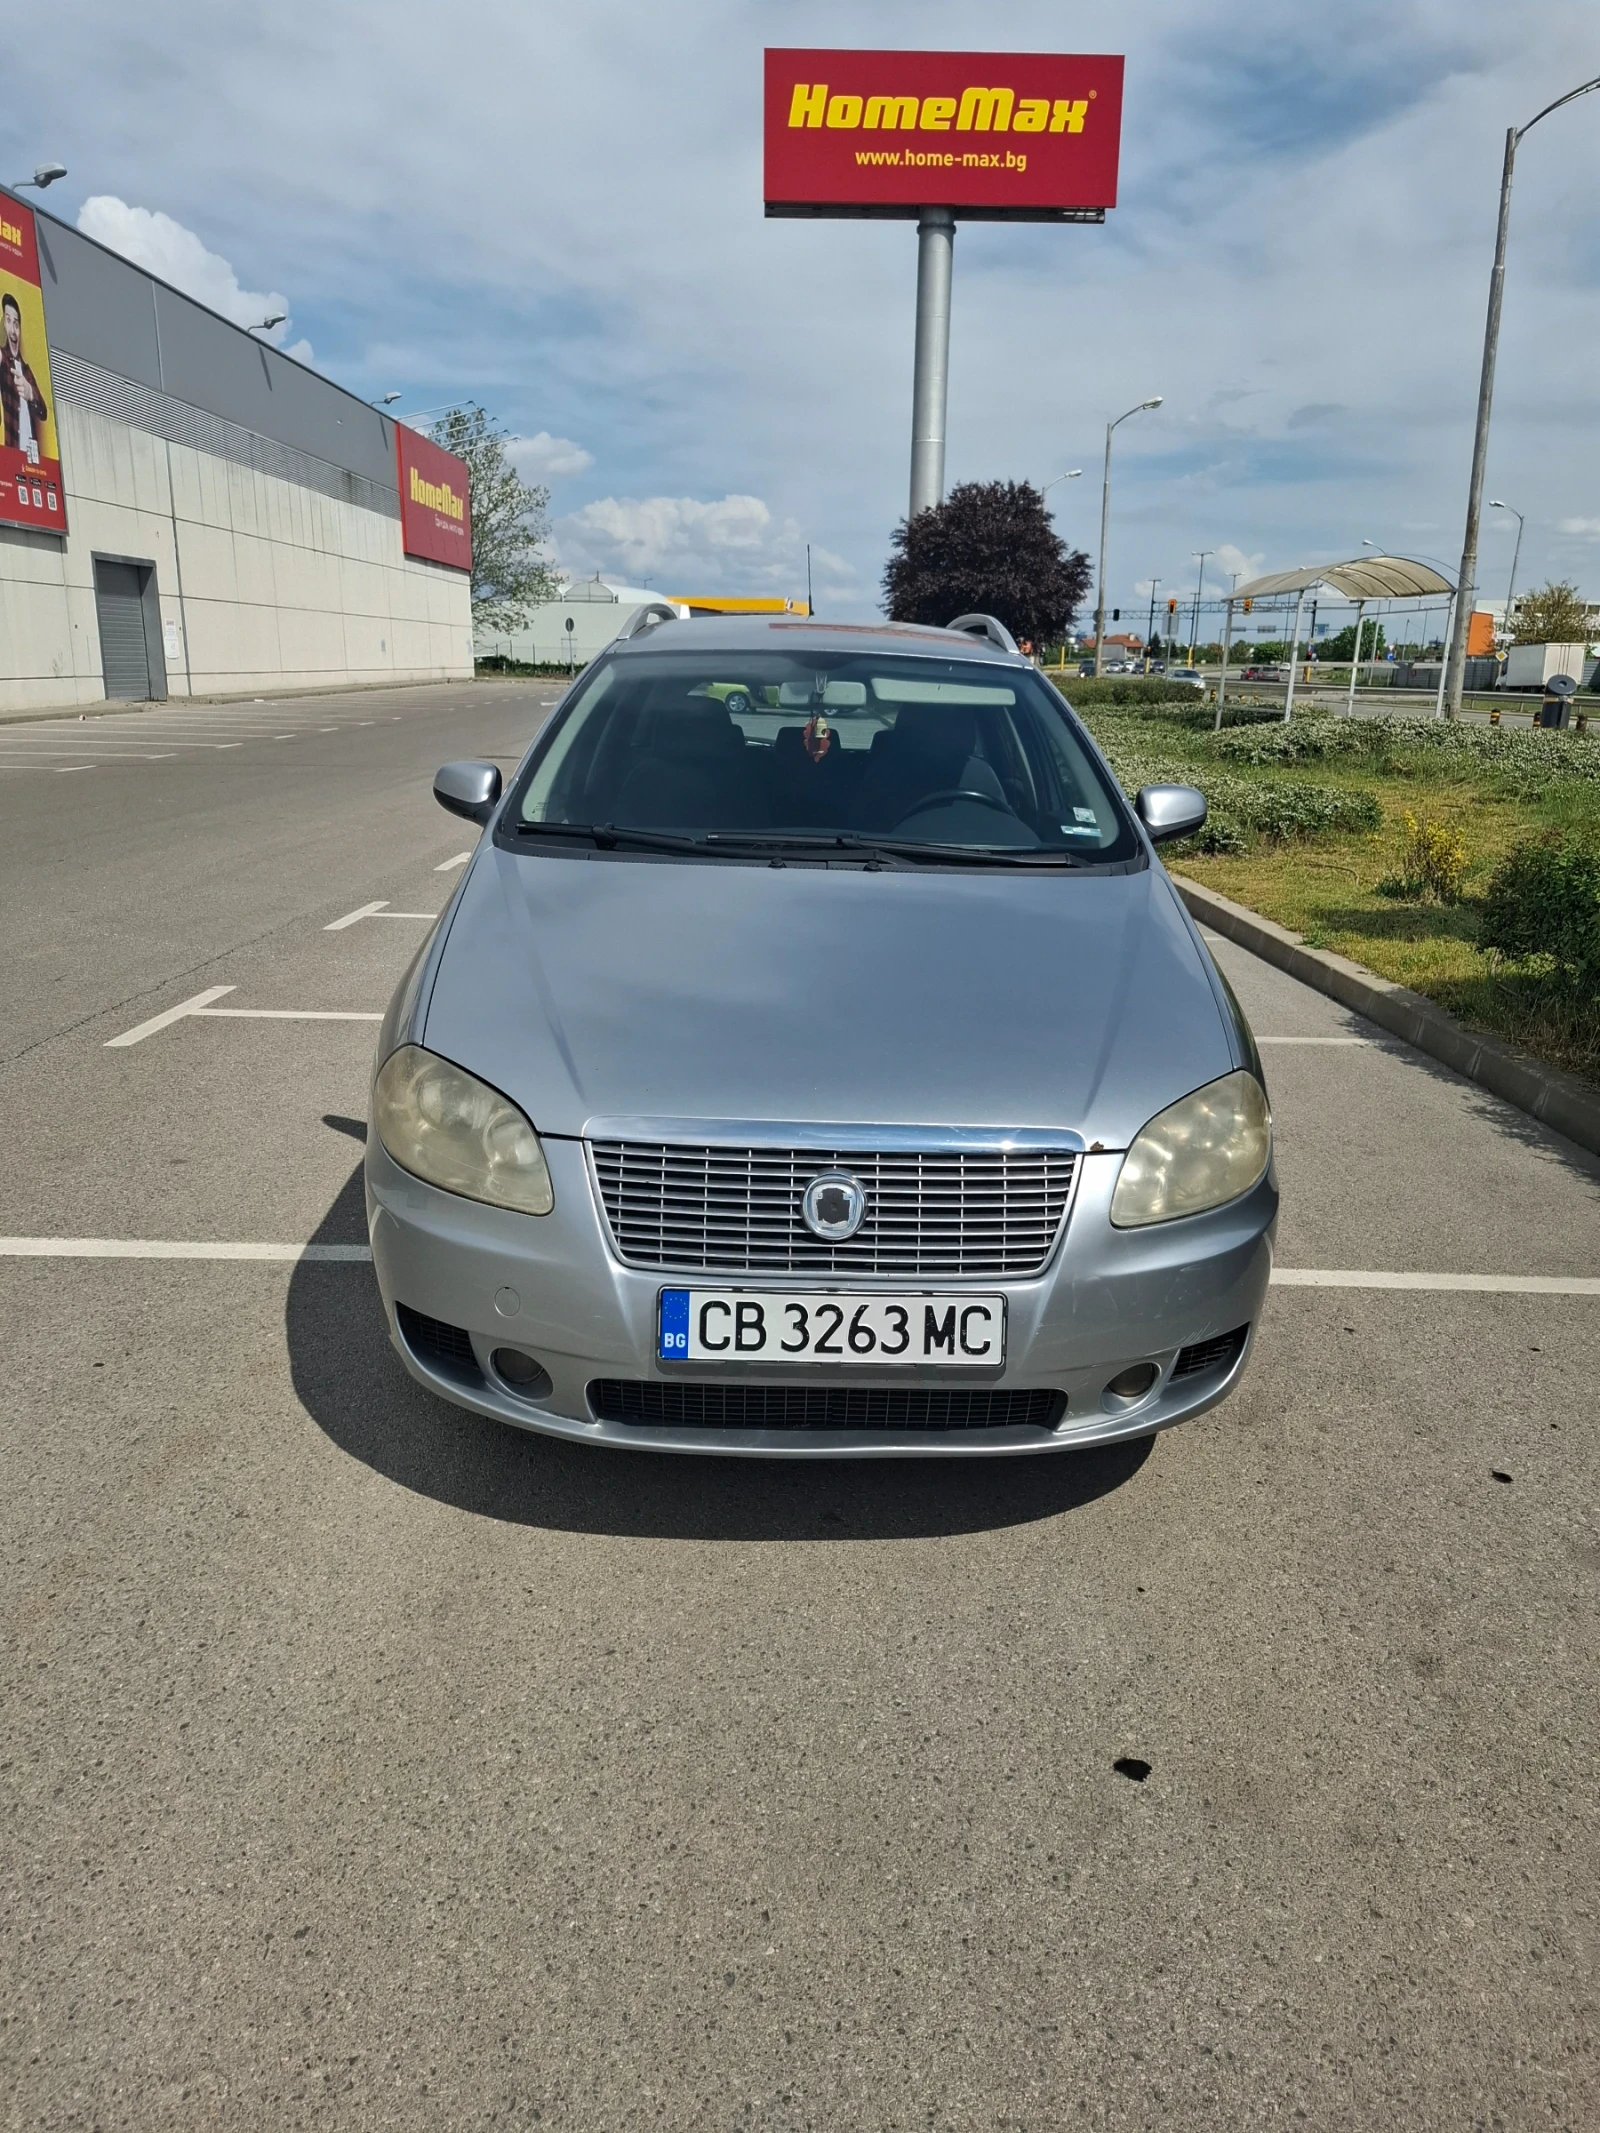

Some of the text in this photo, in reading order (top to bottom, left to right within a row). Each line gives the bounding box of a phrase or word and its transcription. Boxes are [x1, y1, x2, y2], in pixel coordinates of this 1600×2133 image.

[788, 84, 1088, 133] HomeMax
[855, 149, 1027, 172] www.home-max.bg
[0, 214, 21, 246] ax
[410, 466, 463, 521] HomeMax
[664, 1332, 686, 1349] BG
[699, 1300, 992, 1356] CB 3263 MC
